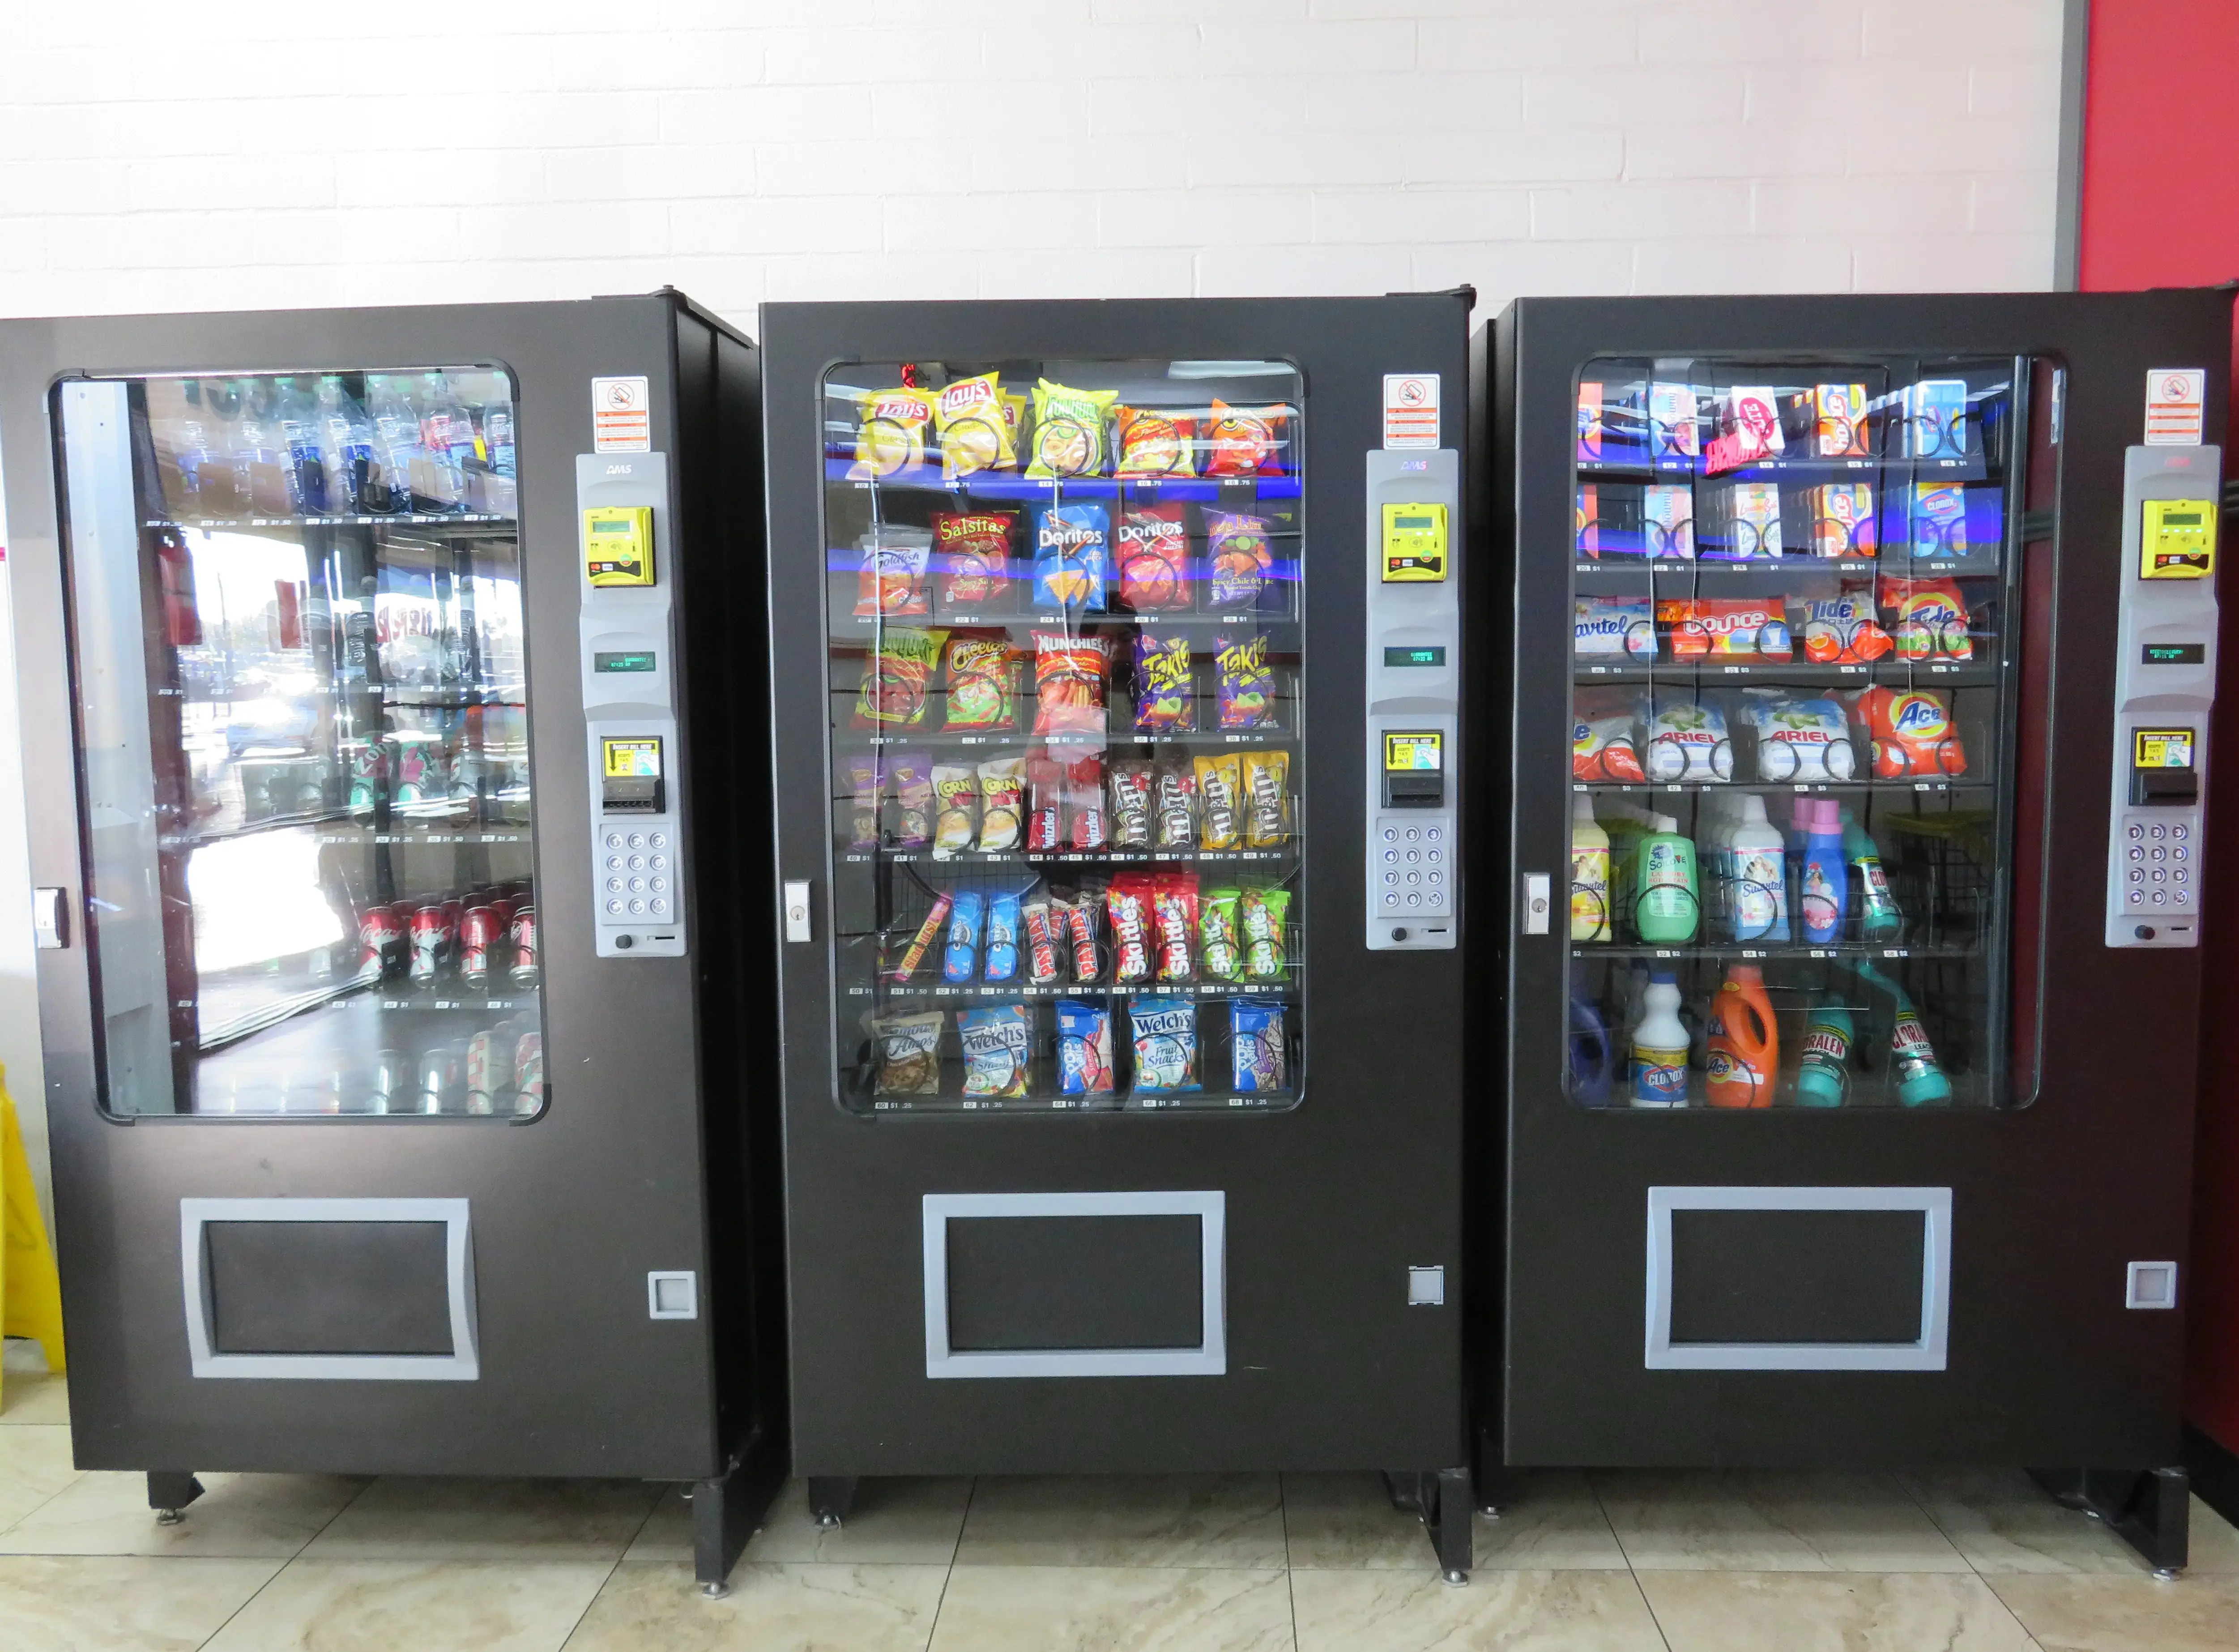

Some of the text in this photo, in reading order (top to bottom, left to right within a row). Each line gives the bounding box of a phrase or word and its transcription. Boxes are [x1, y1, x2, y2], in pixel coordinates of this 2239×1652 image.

[882, 434, 917, 444] Classc
[606, 464, 632, 474] AMS
[940, 518, 1006, 540] Salsitas
[1039, 529, 1103, 549] Doritos
[1118, 521, 1184, 542] Doritos
[876, 552, 920, 569] Goldfish
[1809, 599, 1853, 620] Tide
[1575, 615, 1627, 638] avitel
[1685, 611, 1767, 632] bounce
[1142, 640, 1190, 691] Takis
[1215, 636, 1267, 687] Takis
[1658, 732, 1716, 744] ARIEL
[1770, 730, 1833, 743] ARIEL
[938, 779, 972, 798] CORN
[982, 777, 1019, 795] CORN
[904, 921, 937, 969] Starurst
[1135, 1013, 1191, 1033] Welch's
[967, 1026, 1025, 1050] Welch's
[1147, 1054, 1185, 1067] Snacks
[1155, 1045, 1179, 1056] Fruit
